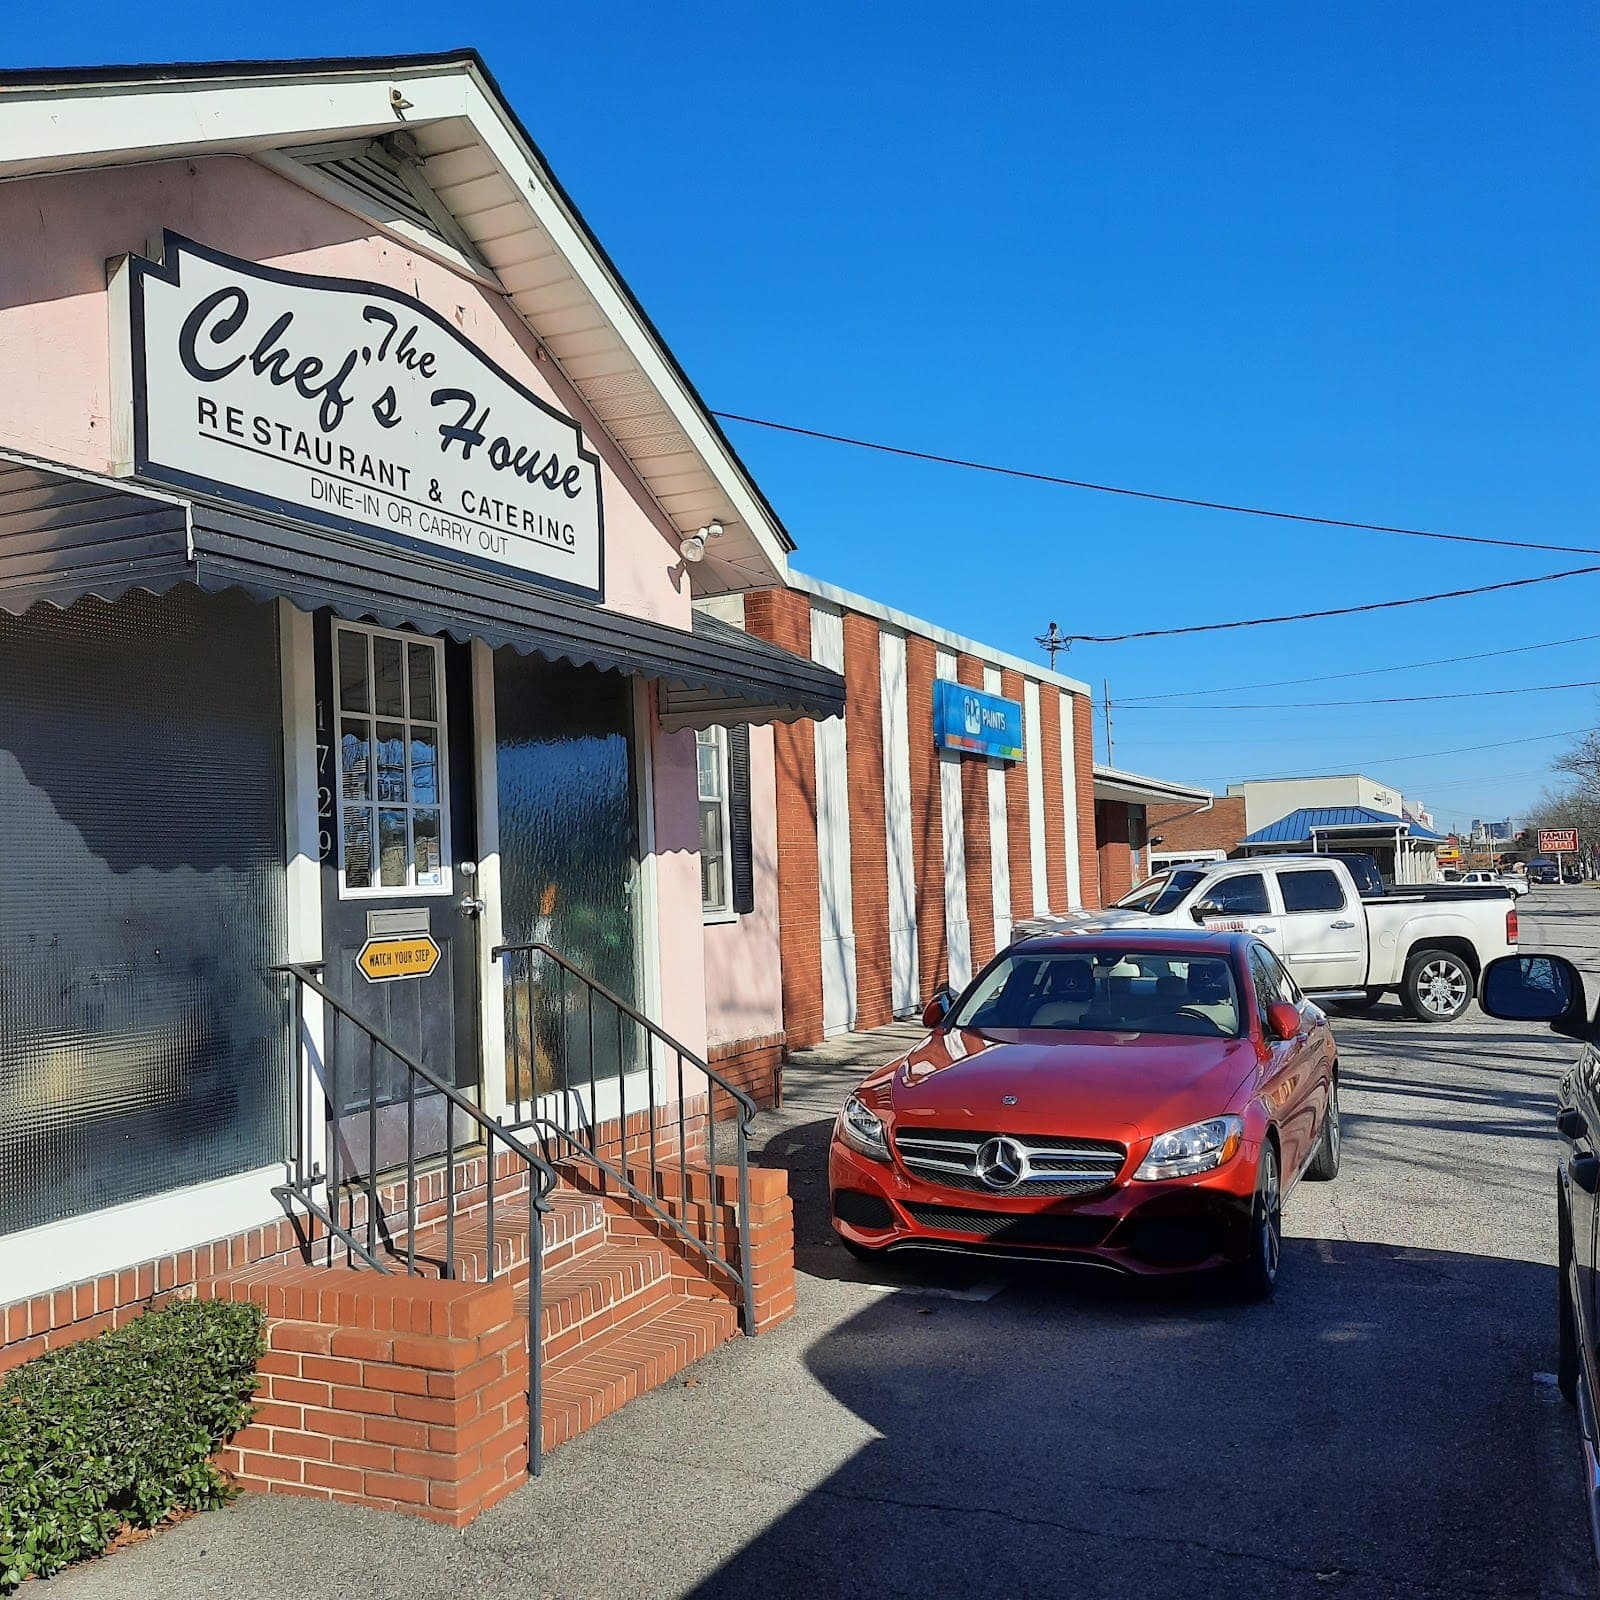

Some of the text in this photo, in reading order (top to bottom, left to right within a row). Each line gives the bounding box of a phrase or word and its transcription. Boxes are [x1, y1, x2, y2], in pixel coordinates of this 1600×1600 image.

[363, 305, 437, 379] The
[178, 286, 583, 499] Chef's House
[198, 396, 576, 547] RESTAURANT & CATERING
[310, 476, 509, 556] DINE-IN OR CARRY OUT
[982, 707, 1006, 731] PAINTS
[1541, 831, 1574, 840] FAMILY
[1542, 841, 1573, 850] DOLLAR
[369, 948, 430, 967] WATCH YOUR STEP
